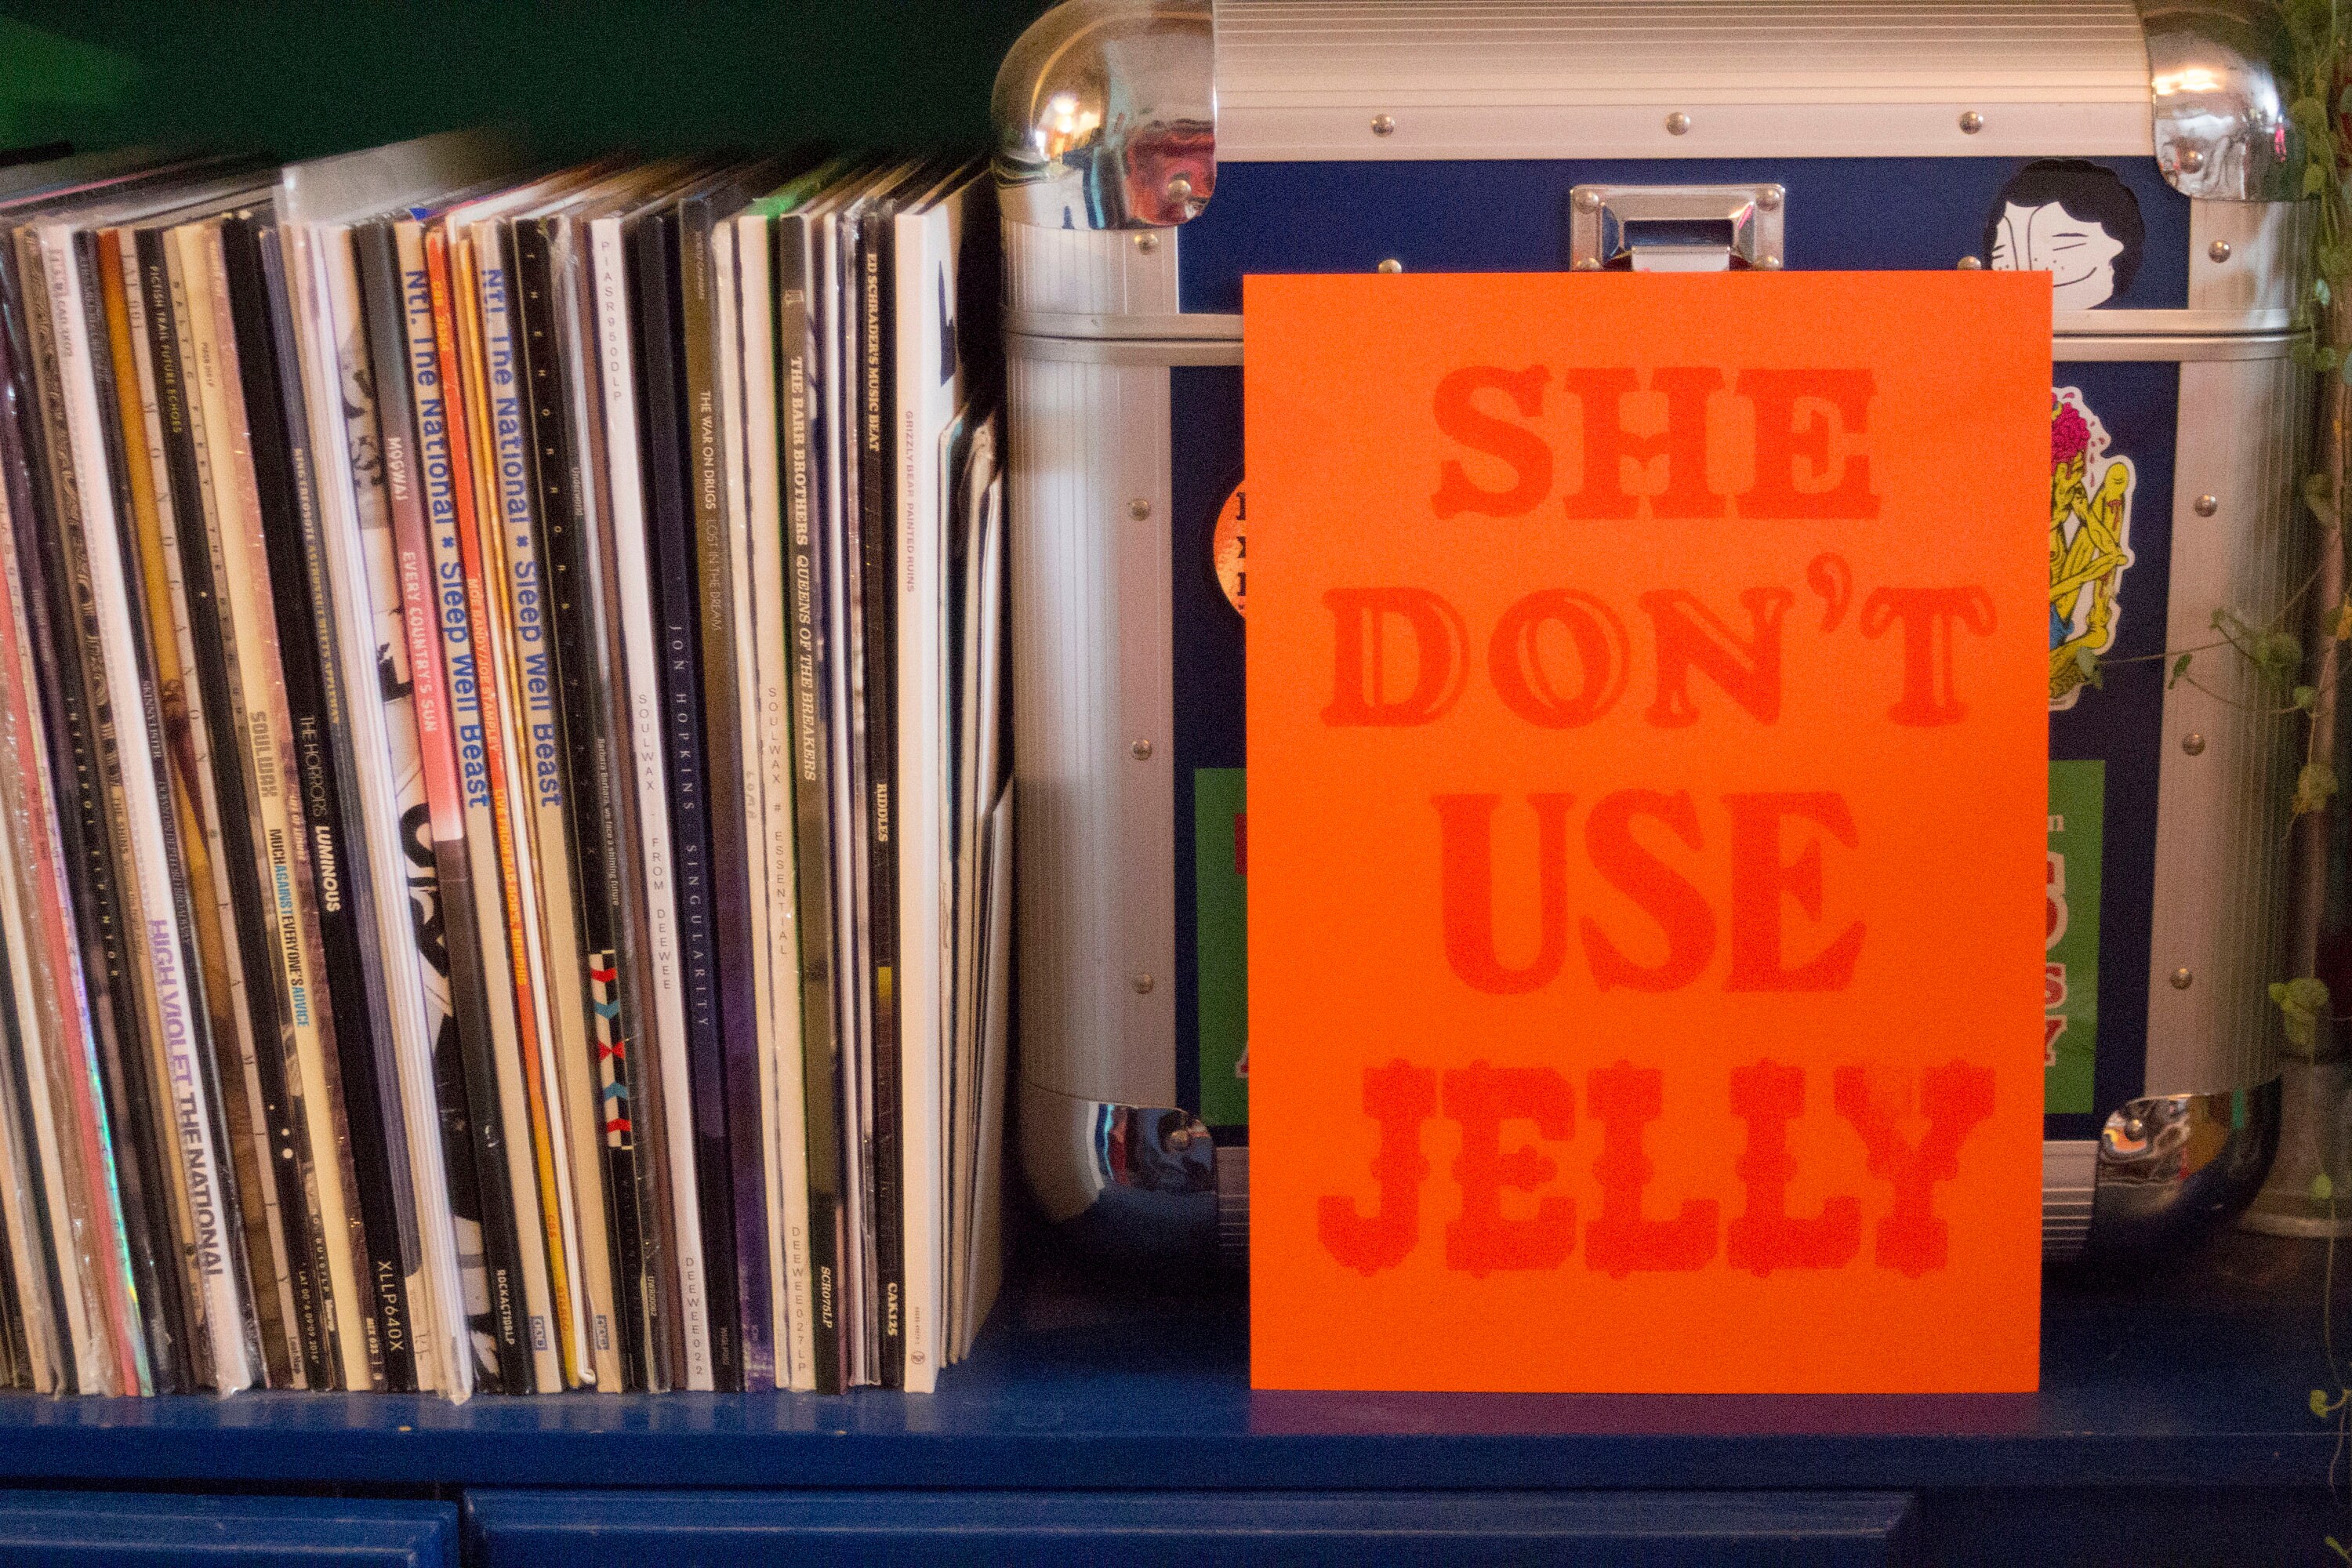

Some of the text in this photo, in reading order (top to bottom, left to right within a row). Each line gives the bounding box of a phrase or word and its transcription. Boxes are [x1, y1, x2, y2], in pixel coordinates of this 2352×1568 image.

[121, 252, 140, 289] LAT
[148, 265, 183, 434] PICTISH TRAIL FUTURE ECHOES
[489, 336, 514, 386] The
[866, 253, 880, 451] ED SCHRADER'S MUSIC BEAT
[292, 448, 306, 477] KING
[495, 398, 531, 522] National
[905, 411, 913, 462] GRIZZLY
[1432, 365, 1882, 520] SHE
[570, 466, 583, 515] Underworld
[699, 391, 720, 630] THE WAR ON DRUGS LOST IN THE DREAM
[404, 270, 490, 808] Ntl. The National Sleep Well Beast
[906, 503, 914, 553] PAINTED
[387, 437, 437, 732] MOGWAI EVERY COUNTRY'S SUN
[467, 579, 481, 607] MOE
[790, 356, 815, 780] THE BARR BROTHERS QUEENS OF THE BREAKERS
[906, 556, 914, 592] RUINS
[511, 561, 543, 642] Sleep
[472, 610, 491, 684] BANDY/JOE
[1321, 553, 1997, 731] DON'T
[141, 680, 156, 721] SKINNY
[524, 652, 553, 710] Well
[481, 687, 499, 751] STAMPLEY
[767, 688, 782, 784] SOULWAX
[65, 697, 96, 824] INTERPOL
[532, 723, 562, 807] Beast
[597, 738, 607, 770] Barbara
[299, 715, 341, 912] THE HORRORS LUMINOUS
[494, 788, 506, 816] LIVE
[603, 808, 611, 818] we
[604, 821, 614, 838] face
[669, 626, 709, 1025] JON HOPKINS SINGULARITY
[877, 784, 887, 841] RIDDLES
[497, 818, 511, 855] FROM
[605, 847, 618, 878] shining
[637, 695, 673, 989] SOULWAX FROM DEEWEE
[502, 857, 514, 883] BAD
[608, 880, 620, 906] future
[774, 831, 787, 955] ESSENTIAL
[1435, 789, 1867, 995] USE
[510, 928, 527, 985] MEMPHIS
[146, 920, 223, 1276] HIGH VIOLET THE NATIONAL
[1319, 1058, 1995, 1279] JELLY
[376, 1260, 404, 1352] XLLP640X
[820, 1266, 833, 1327] SCR075LP
[887, 1282, 898, 1336] CAK125
